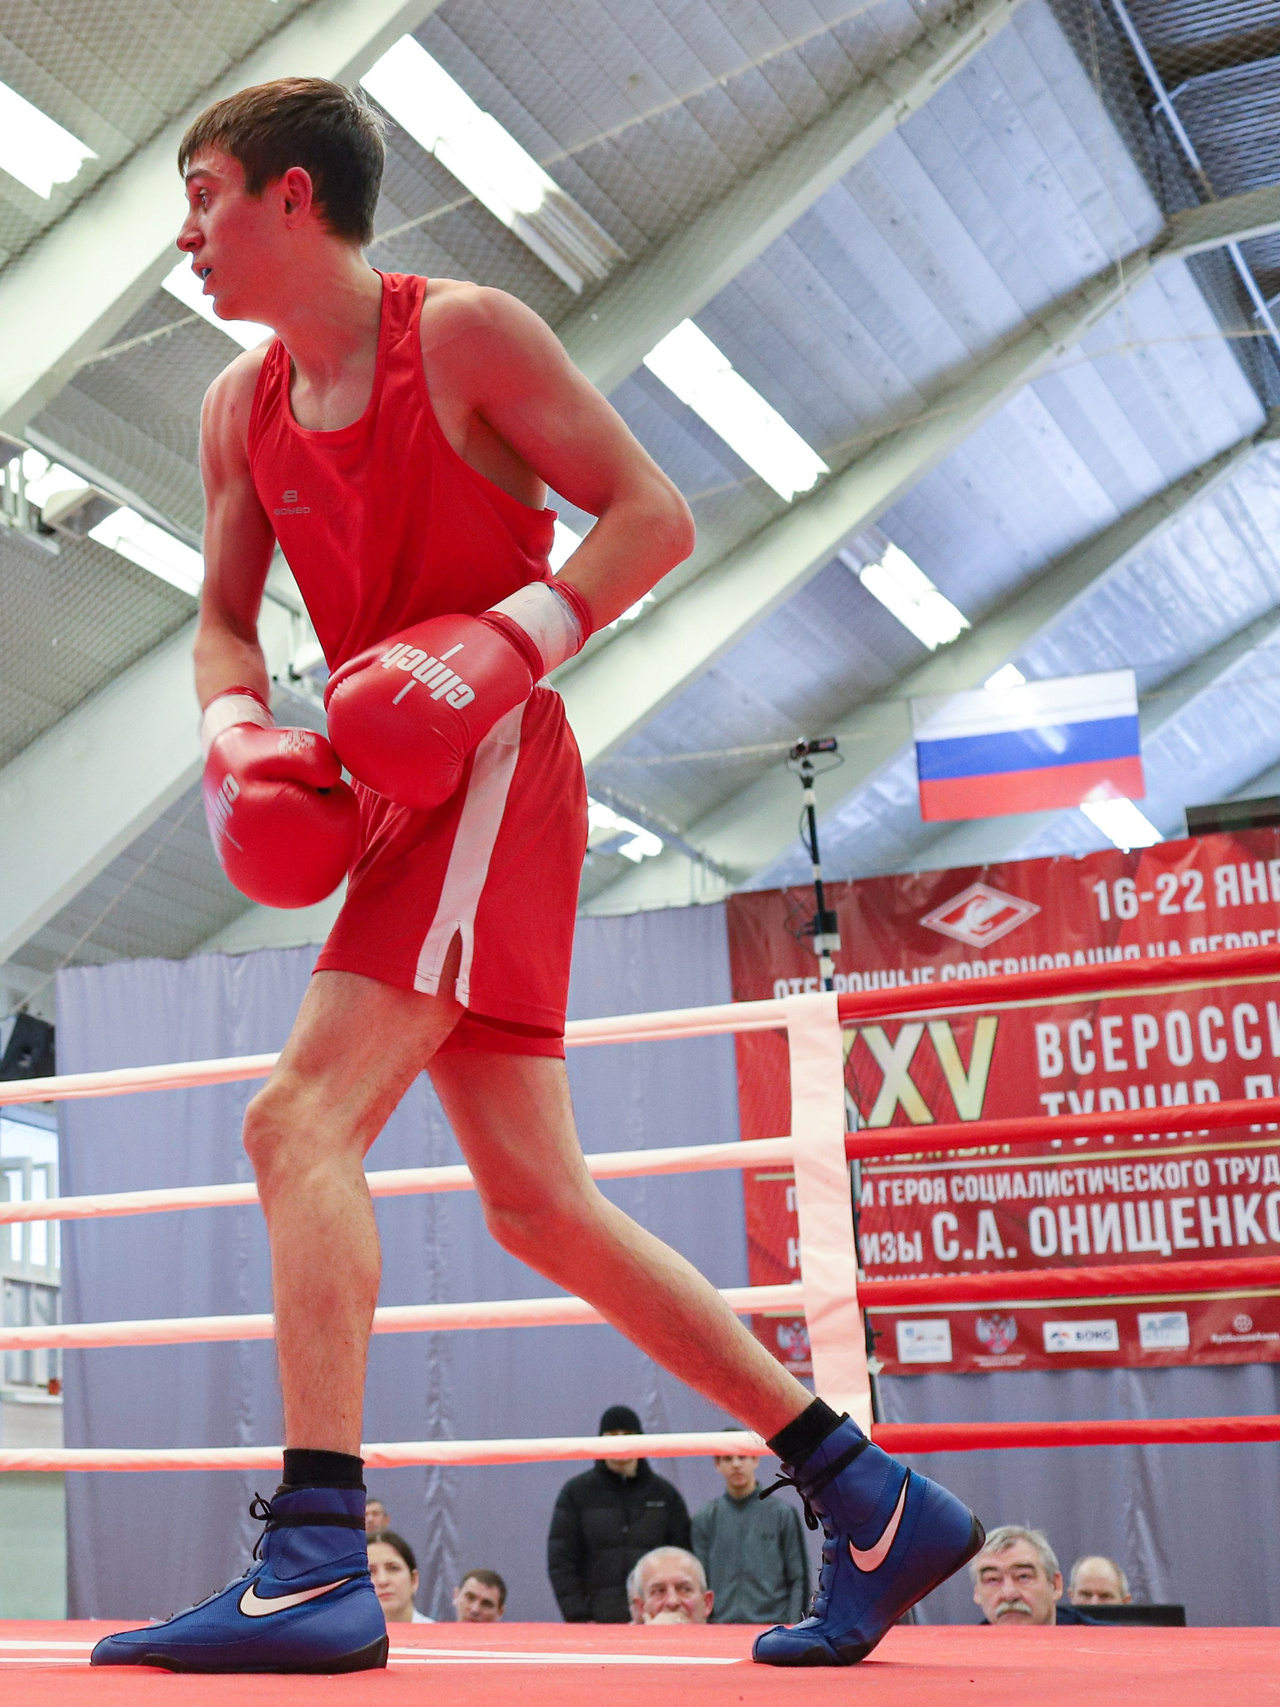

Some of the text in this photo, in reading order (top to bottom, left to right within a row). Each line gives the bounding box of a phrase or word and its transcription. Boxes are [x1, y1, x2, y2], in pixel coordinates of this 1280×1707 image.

[380, 642, 476, 710] clinch
[1093, 869, 1207, 921] 16-22
[878, 1177, 948, 1207] ГЕРОЯ
[950, 1159, 1210, 1204] СОЦИАЛИСТИЧЕСКОГО
[860, 1231, 924, 1265] ИЗЫ
[932, 1209, 1018, 1262] С.А.
